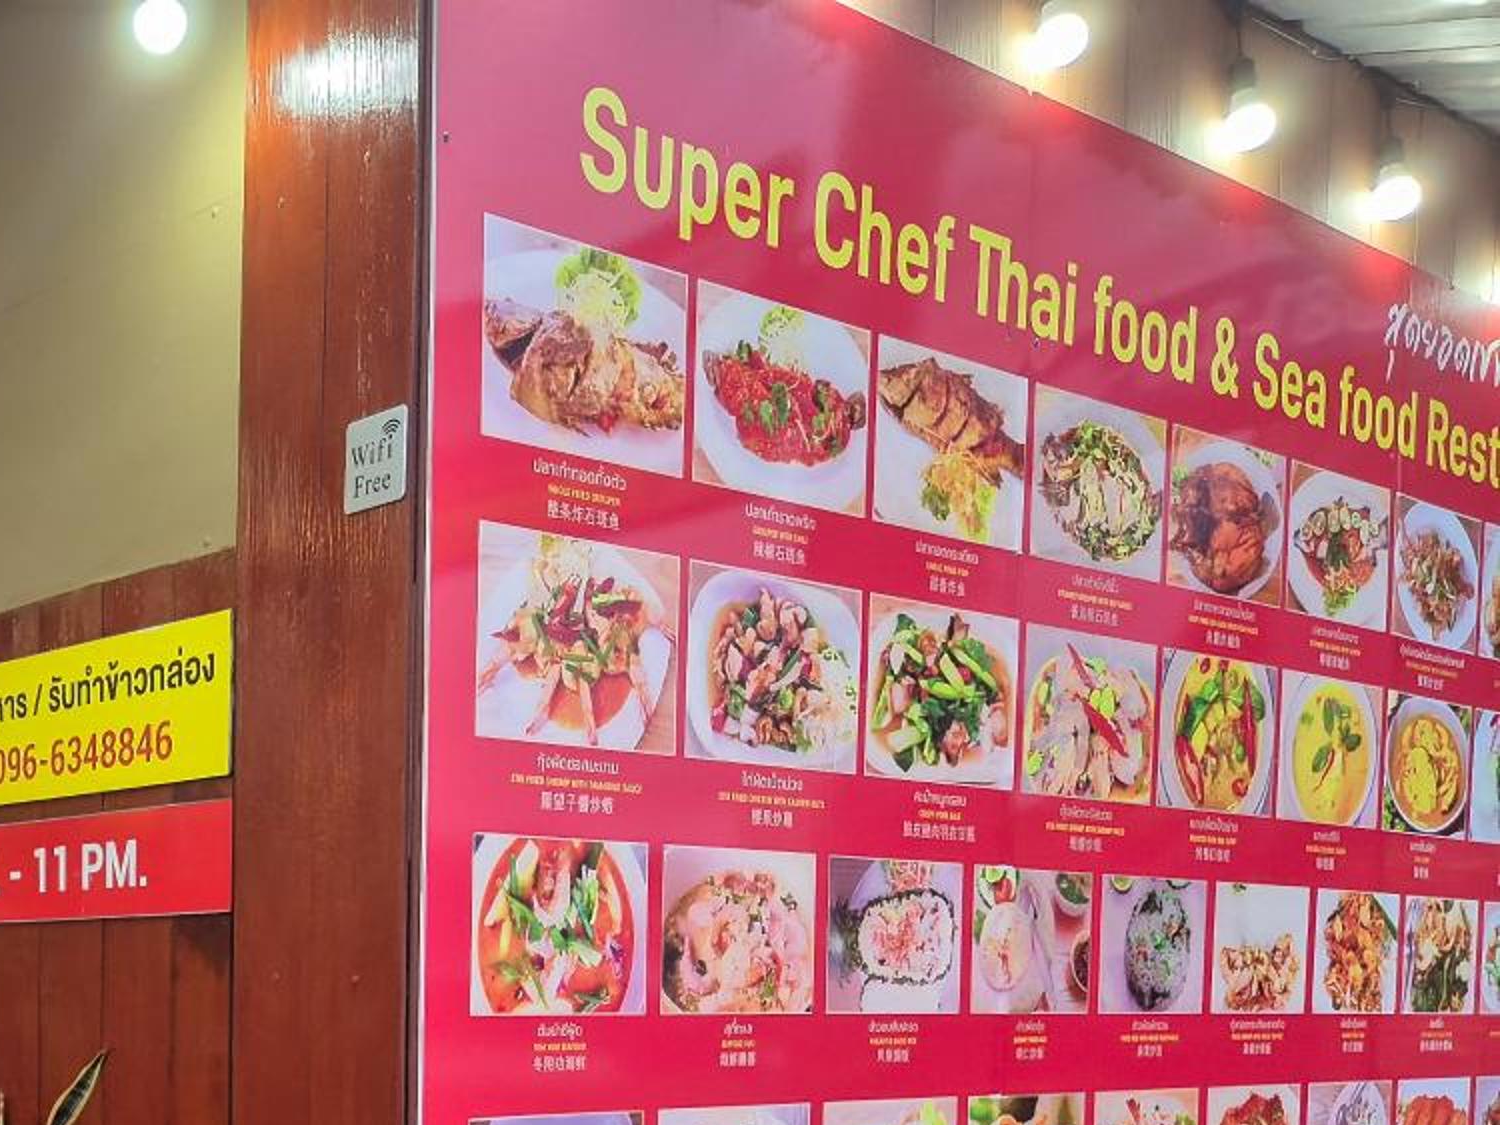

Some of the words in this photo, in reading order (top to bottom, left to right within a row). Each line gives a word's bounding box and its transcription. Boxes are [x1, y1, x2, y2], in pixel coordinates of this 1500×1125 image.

[580, 86, 794, 248] Super
[814, 171, 956, 303] Chef
[969, 224, 1077, 346] Thai
[1093, 274, 1198, 384] food
[1209, 316, 1240, 398] &
[1253, 333, 1327, 429] Sea
[1338, 365, 1418, 458] food
[353, 473, 392, 498] Free
[49, 647, 216, 713] รับทำข้าวกล่อง
[33, 845, 68, 893] 11
[80, 838, 148, 892] PM.
